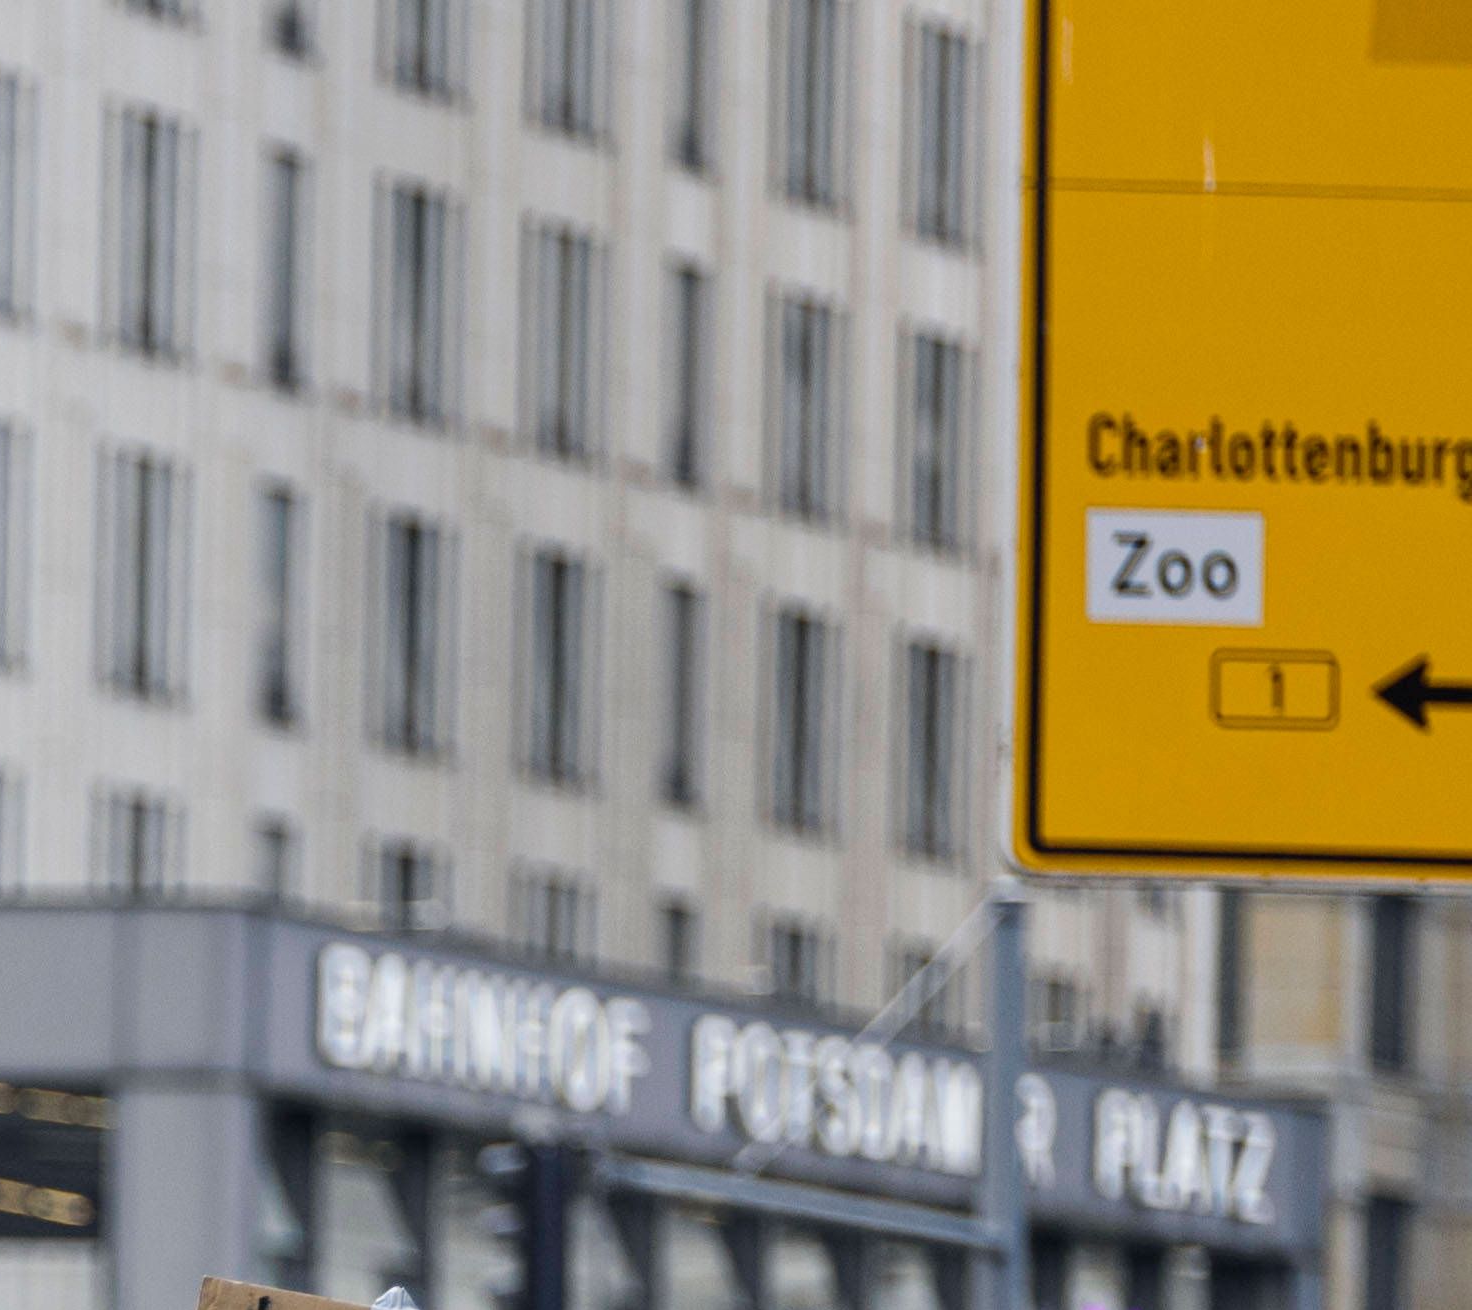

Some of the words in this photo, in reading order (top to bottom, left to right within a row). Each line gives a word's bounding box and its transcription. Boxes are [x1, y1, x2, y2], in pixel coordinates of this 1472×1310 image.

[1086, 409, 1472, 505] Charlottenburg
[1111, 529, 1241, 601] Zoo
[317, 942, 651, 1114] BAHNHOF
[691, 1013, 1058, 1190] POTSDAMR
[1094, 1086, 1277, 1226] PLATZ
